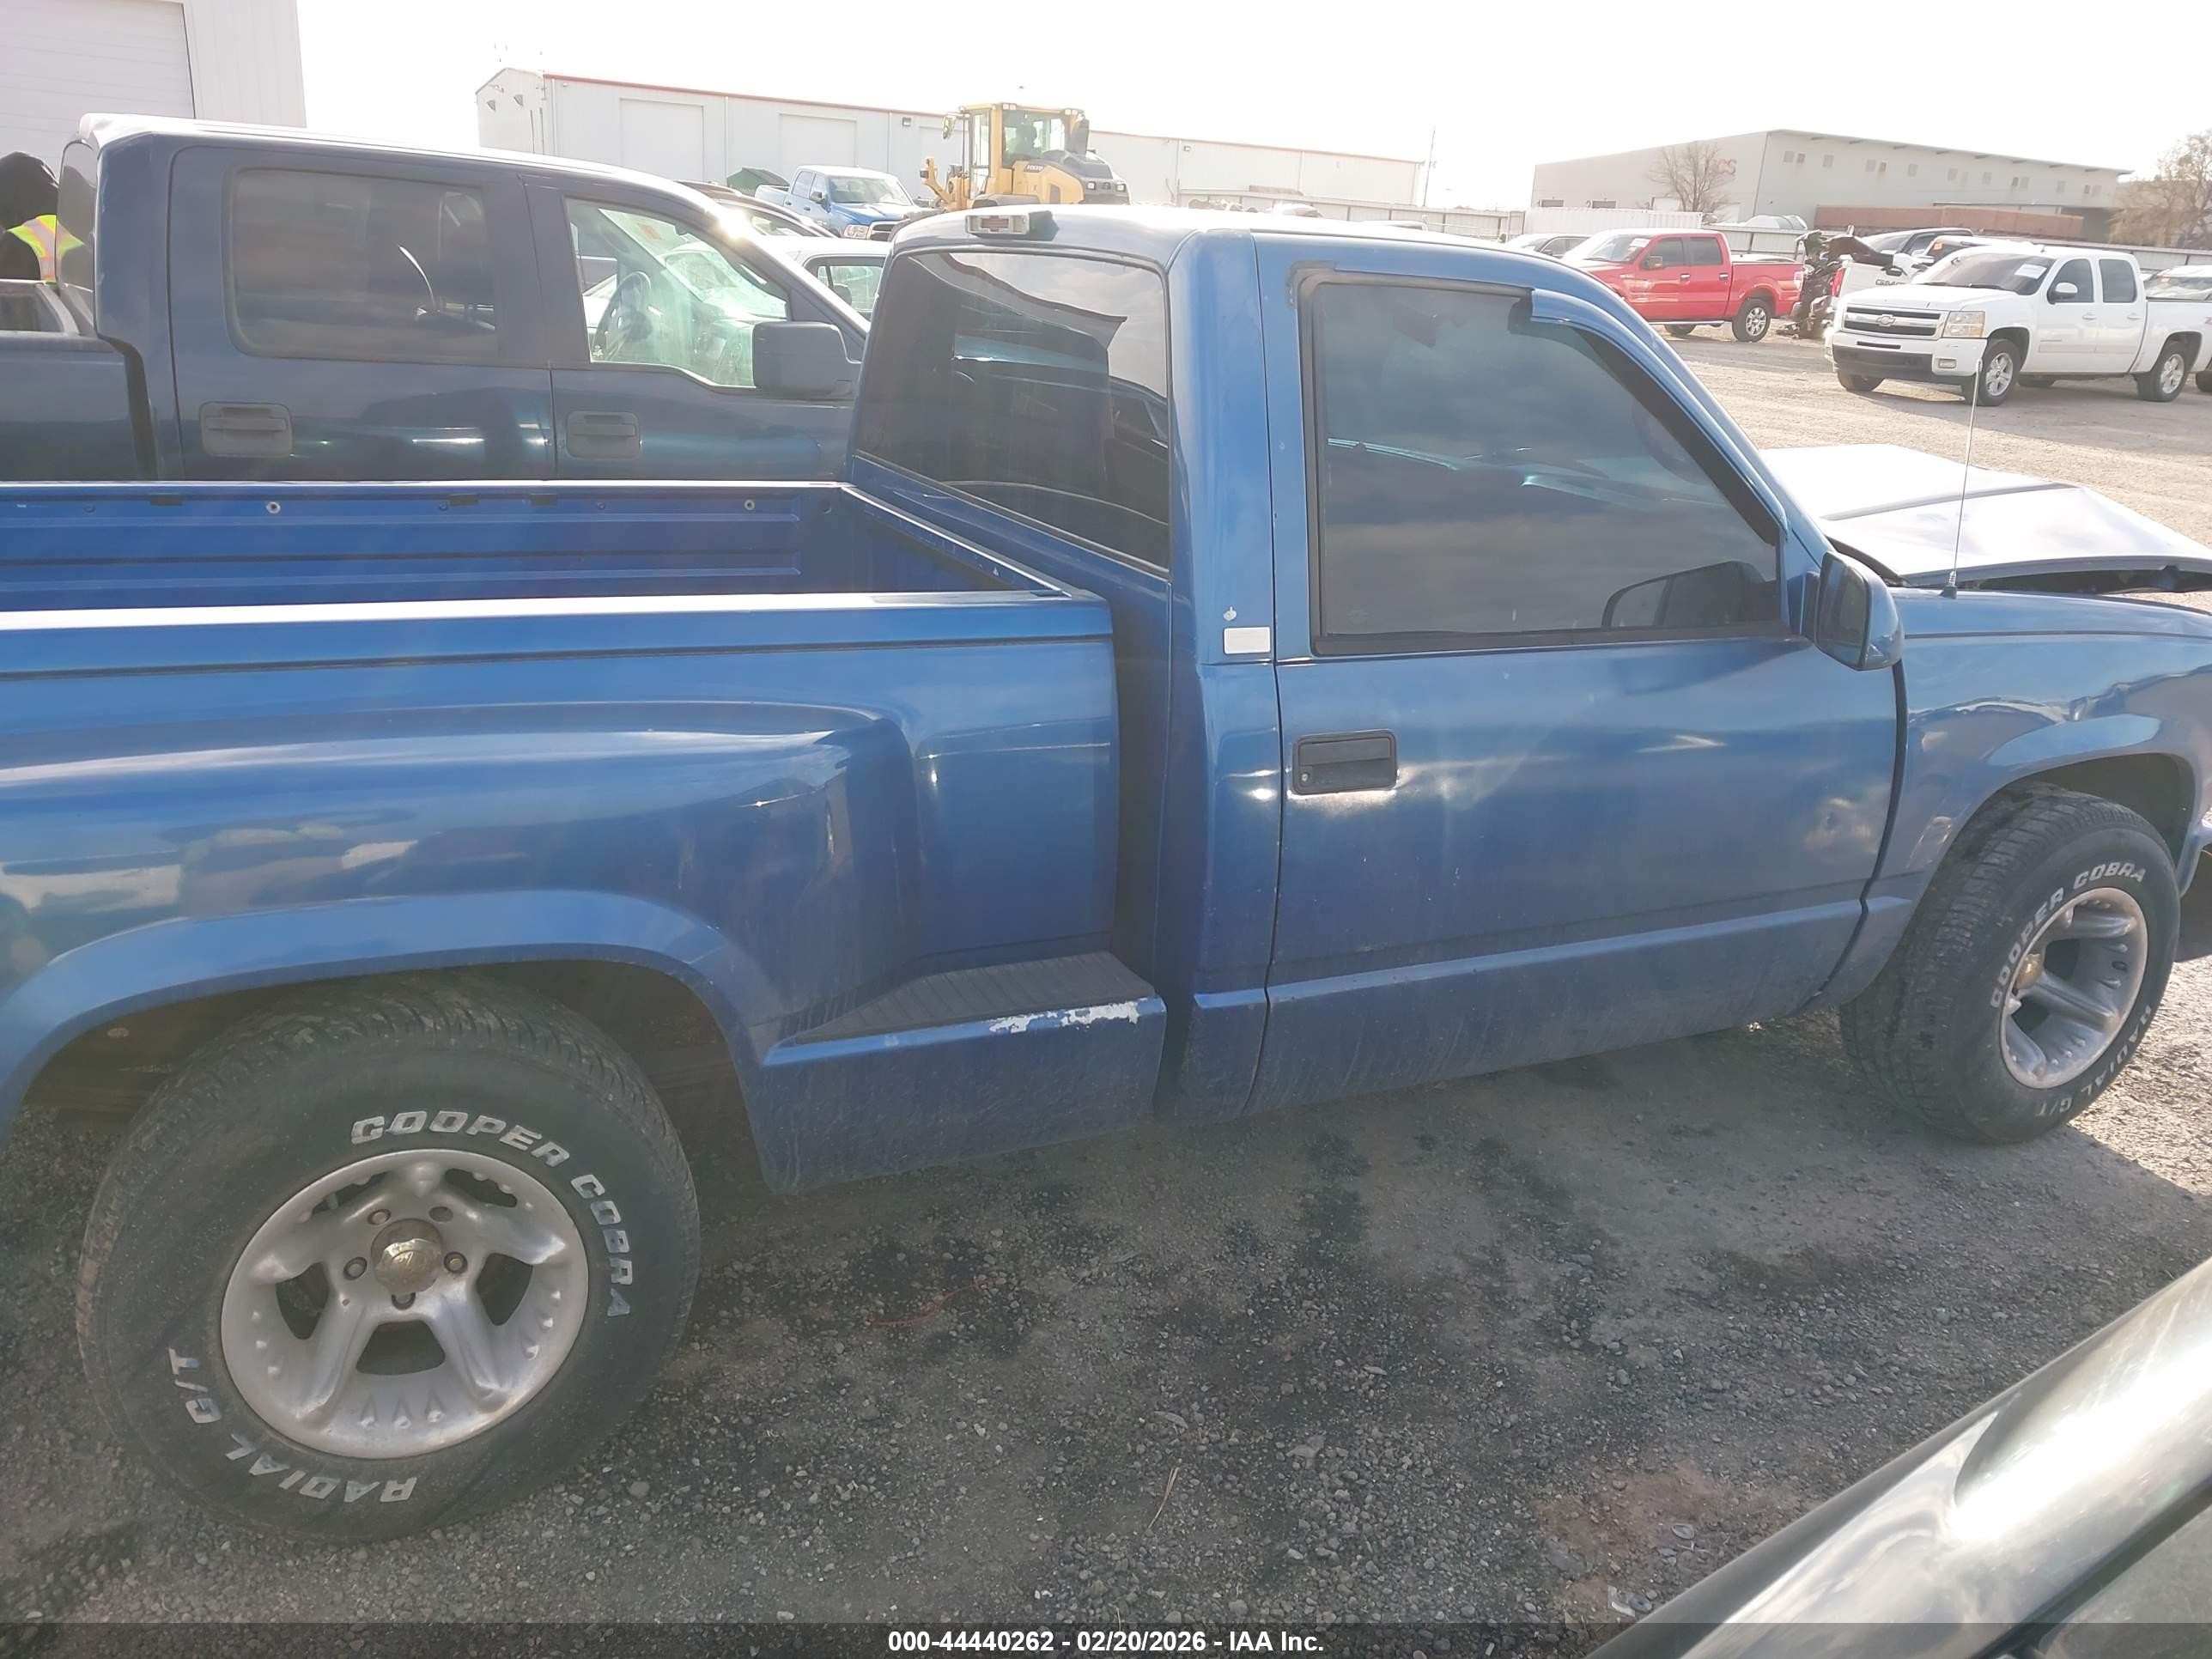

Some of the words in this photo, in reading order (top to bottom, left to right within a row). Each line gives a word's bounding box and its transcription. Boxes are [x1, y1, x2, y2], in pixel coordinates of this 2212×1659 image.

[1990, 887, 2064, 1008] COOPER
[2073, 861, 2147, 888] COBRA
[2081, 1004, 2152, 1097] RADIAL
[350, 1110, 570, 1167] COOPER
[570, 1174, 634, 1317] COBRA
[167, 1346, 222, 1425] G/T
[225, 1432, 418, 1504] RADIAL
